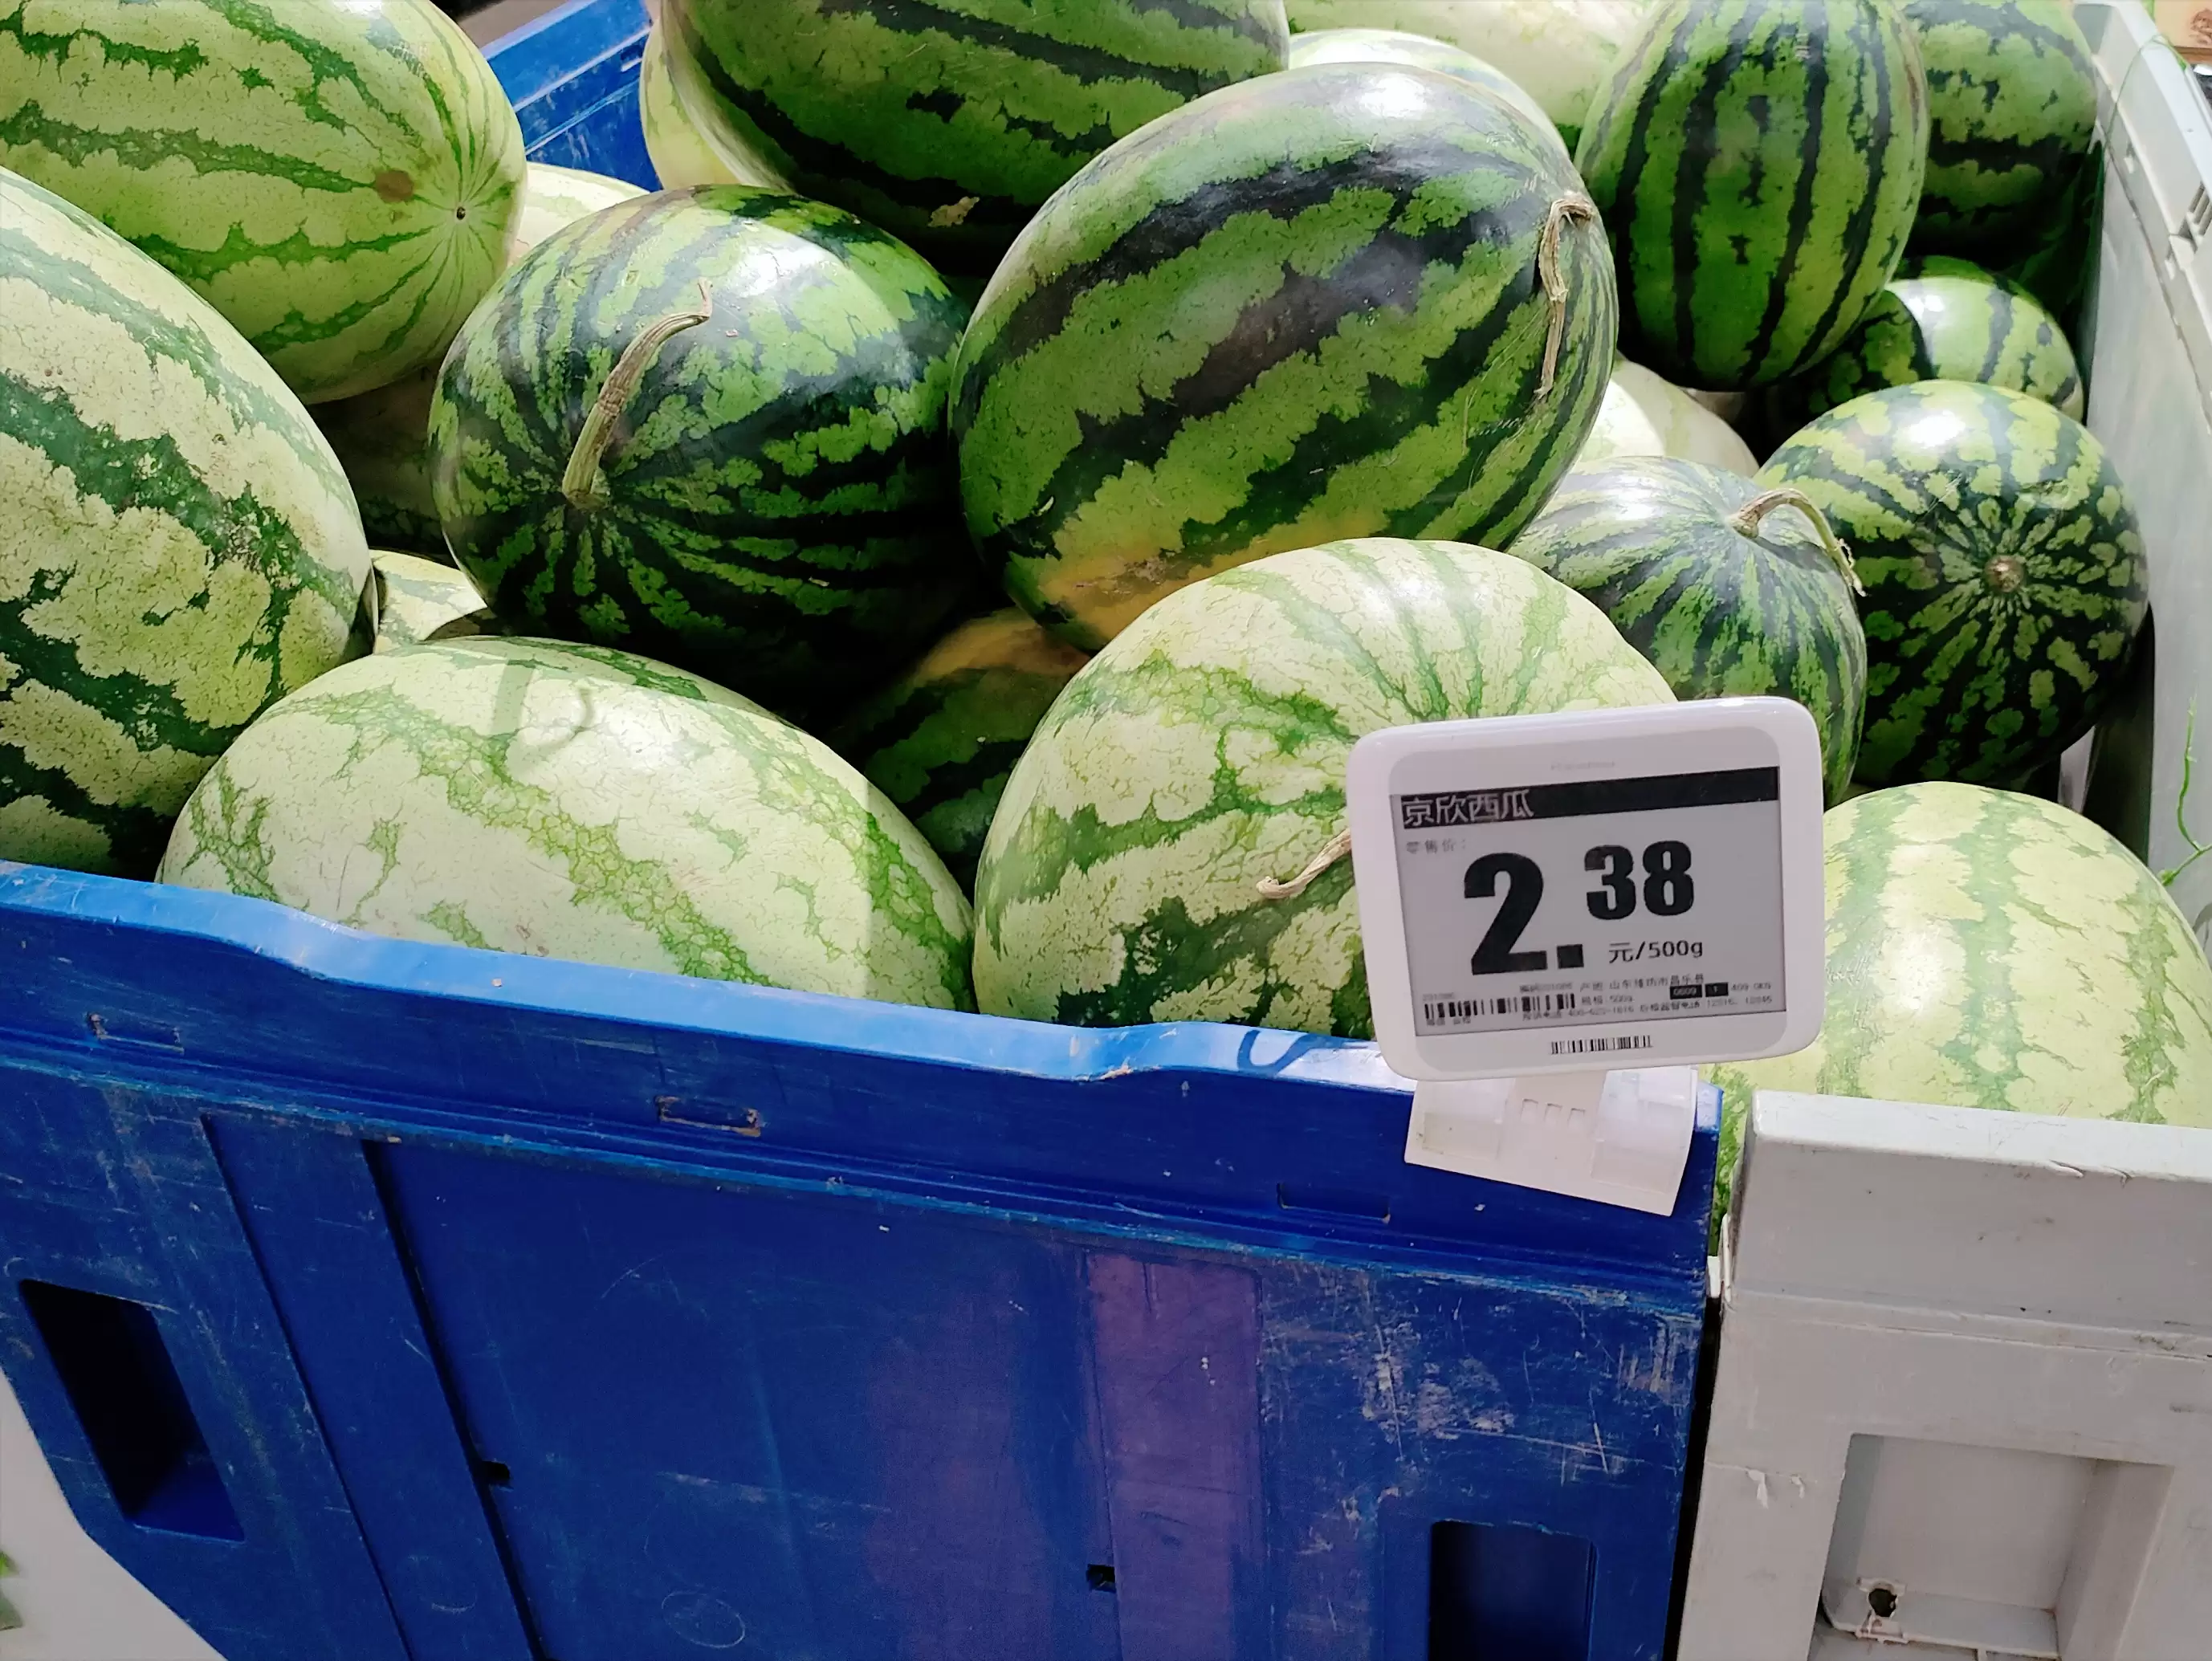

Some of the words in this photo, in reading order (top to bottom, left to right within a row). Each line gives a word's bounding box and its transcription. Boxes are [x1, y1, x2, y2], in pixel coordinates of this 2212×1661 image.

[1403, 789, 1534, 827] 京欣西瓜
[1608, 940, 1704, 964] 元/500g
